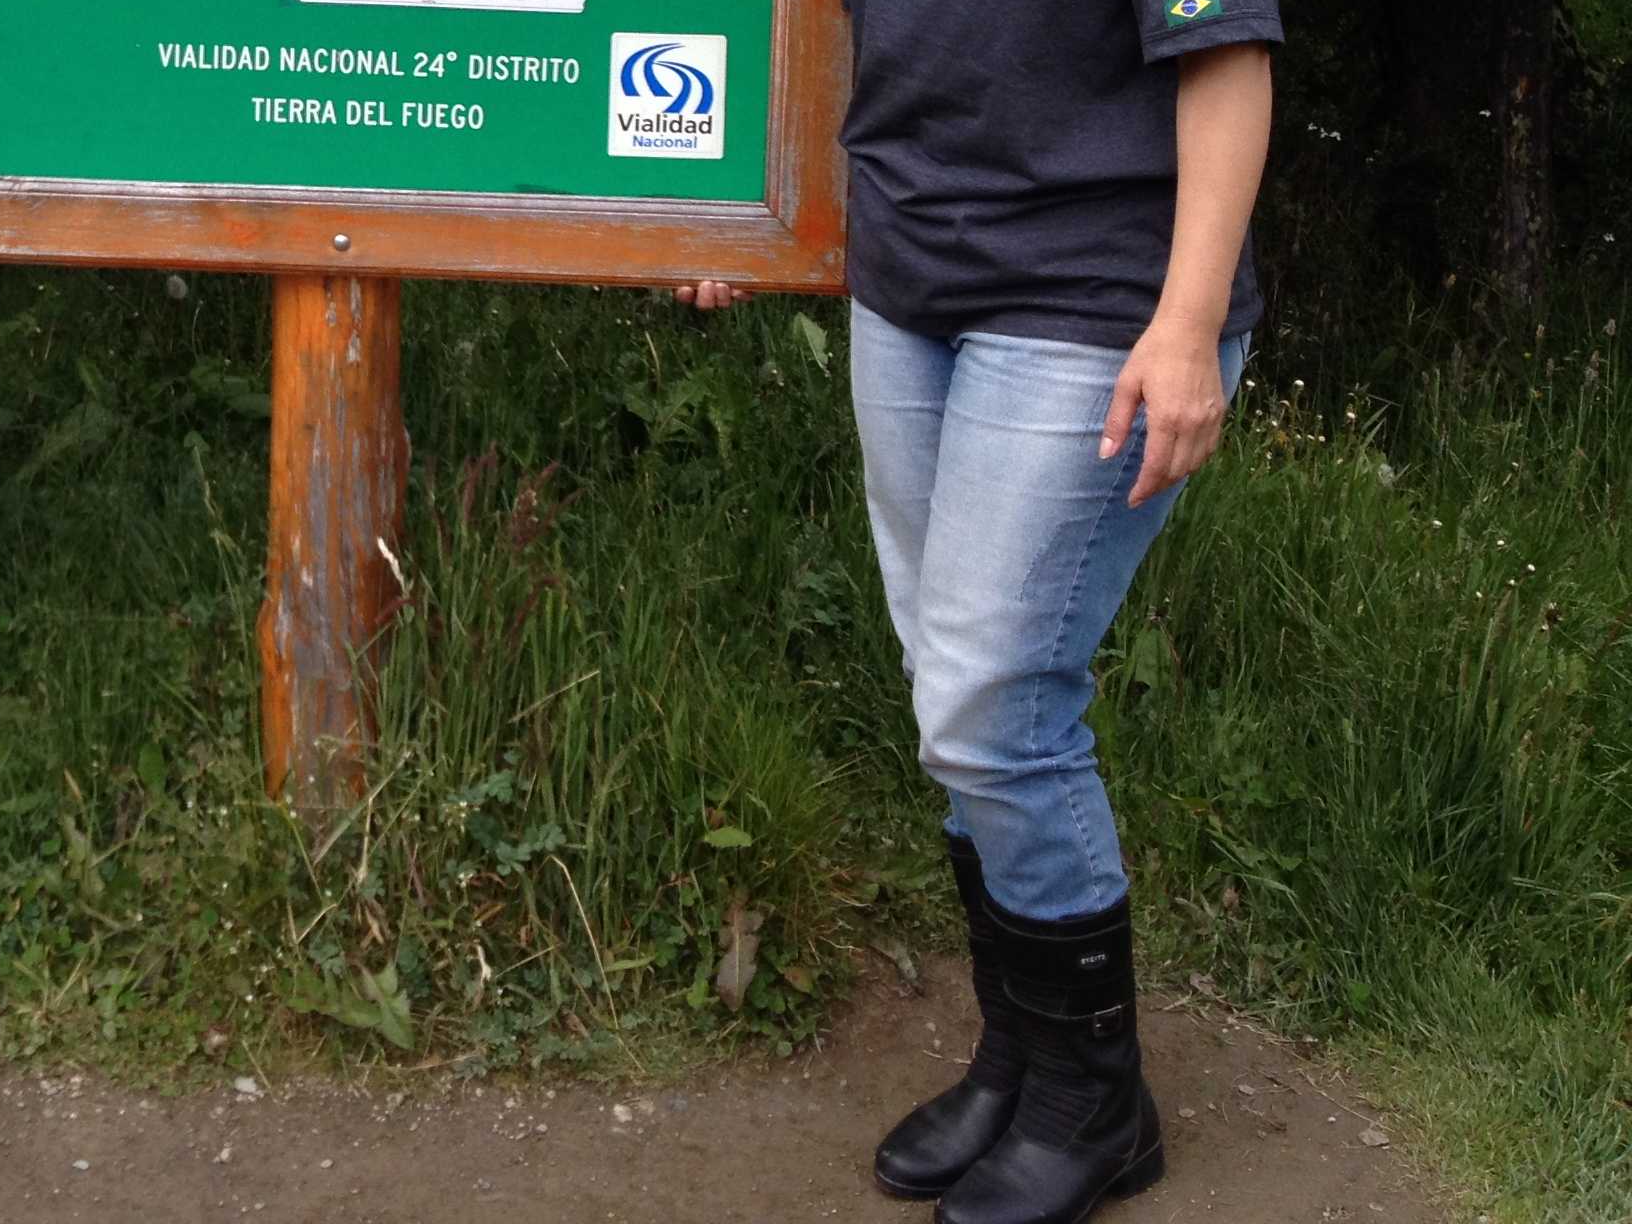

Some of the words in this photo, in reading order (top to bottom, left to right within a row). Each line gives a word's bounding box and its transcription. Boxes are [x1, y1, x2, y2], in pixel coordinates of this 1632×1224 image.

[158, 43, 270, 71] VIALIDAD
[279, 47, 405, 76] NACIONAL
[468, 54, 580, 84] DISTRITO
[251, 97, 337, 125] TIERRA
[346, 100, 393, 126] DEL
[402, 102, 484, 130] FUEGO
[617, 113, 714, 135] Vialidad
[632, 134, 698, 149] Nacional
